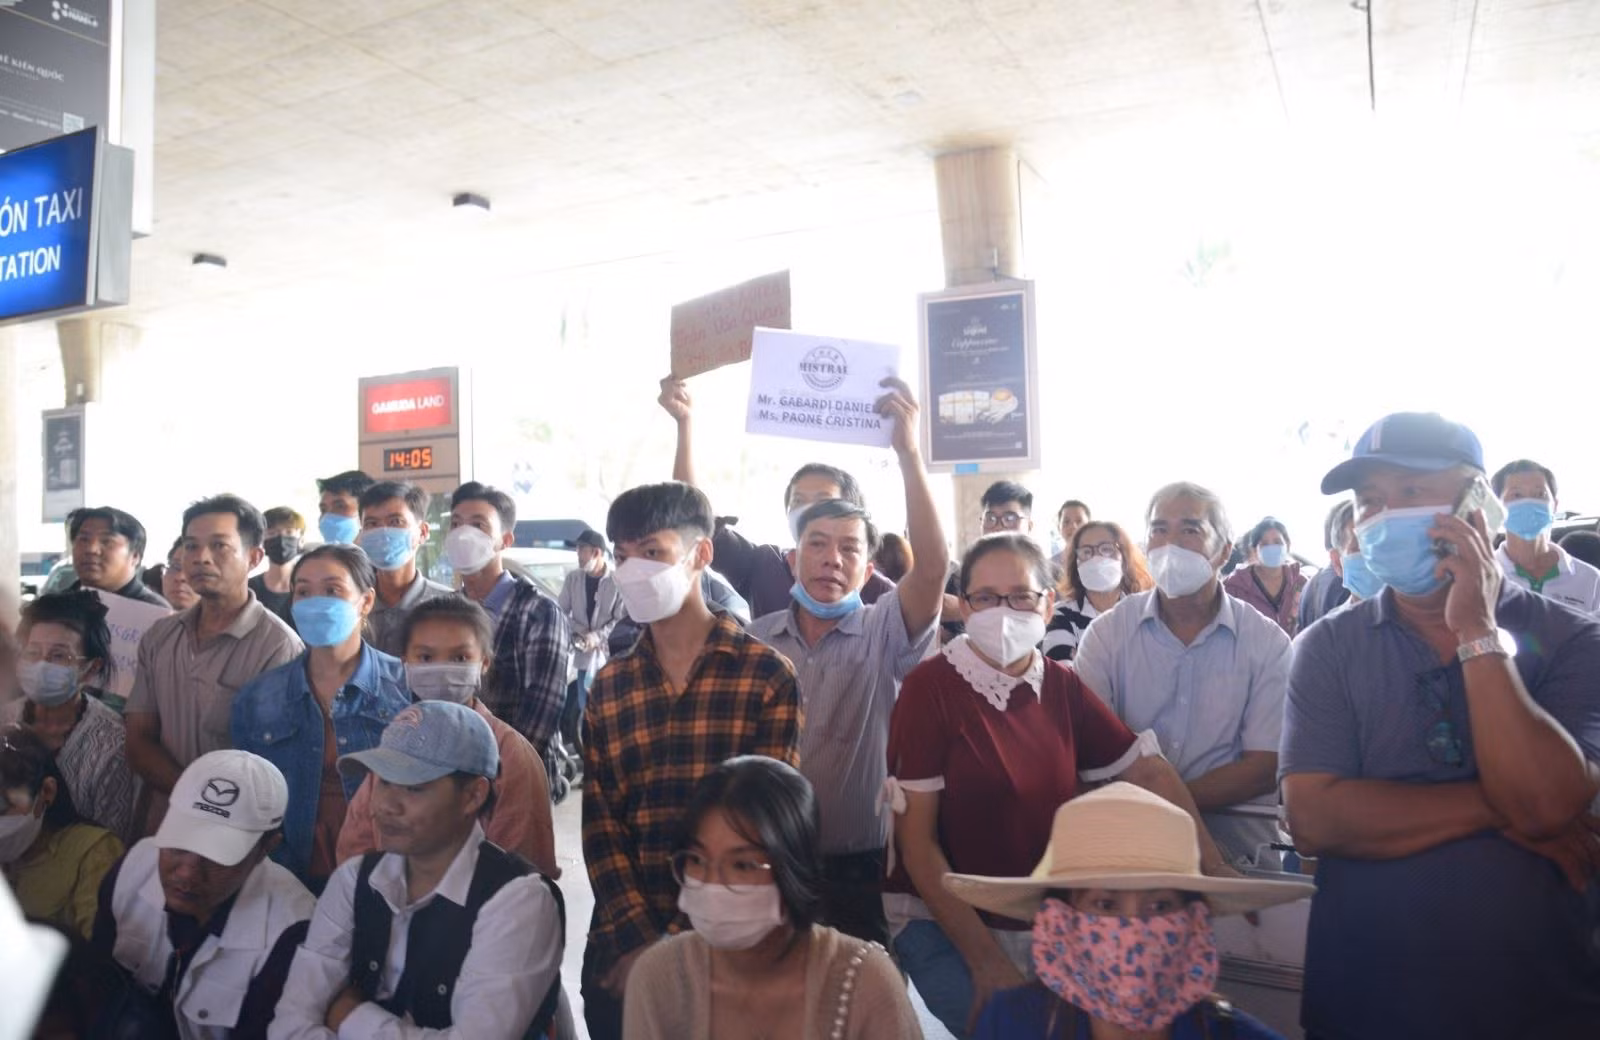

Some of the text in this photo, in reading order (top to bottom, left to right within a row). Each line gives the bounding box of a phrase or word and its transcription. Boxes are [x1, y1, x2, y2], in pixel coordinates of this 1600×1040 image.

[34, 187, 83, 228] TAXI
[417, 394, 444, 409] LAND
[757, 394, 874, 413] Mr. GABARDI DANIE
[758, 410, 881, 429] Ms. PAONE CRISTINA
[389, 448, 432, 469] 14:05
